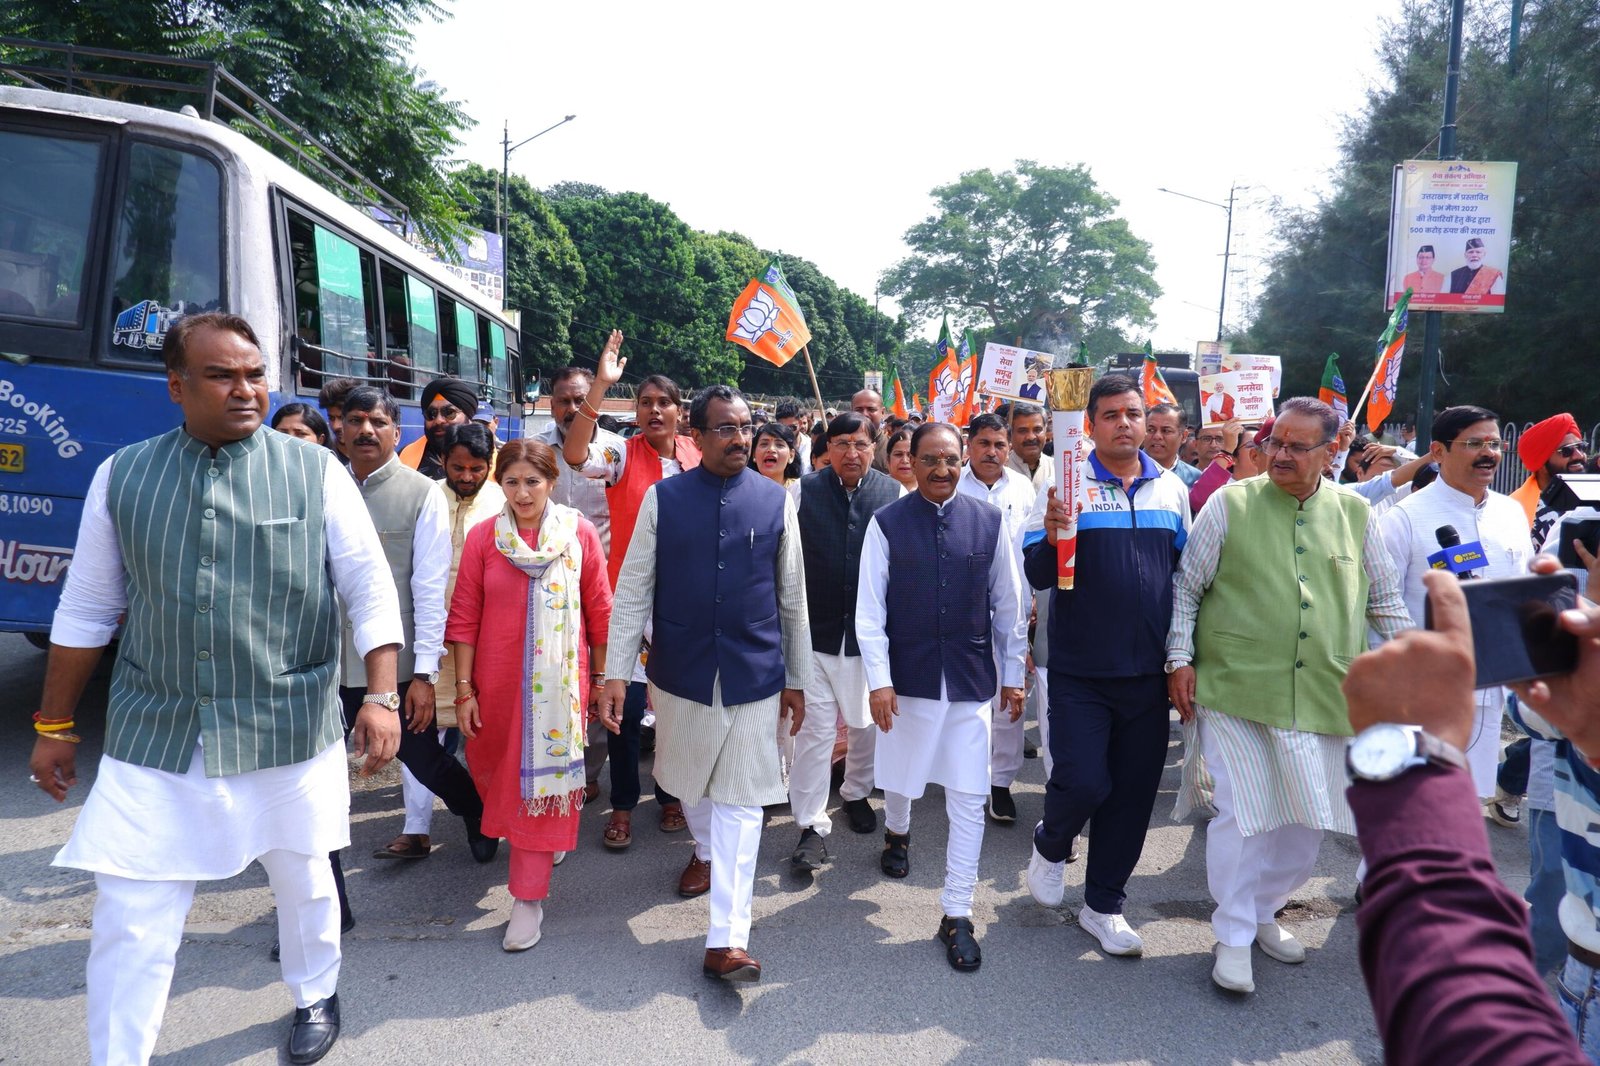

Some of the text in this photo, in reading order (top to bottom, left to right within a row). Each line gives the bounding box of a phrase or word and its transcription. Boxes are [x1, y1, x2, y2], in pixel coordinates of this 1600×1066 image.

[1460, 192, 1489, 201] प्रस्तावित
[1445, 204, 1460, 212] मेला
[1416, 214, 1425, 222] की
[1454, 215, 1464, 225] हेतु
[1477, 216, 1491, 224] द्वारा
[1460, 226, 1469, 234] की
[1000, 356, 1013, 366] सेवा
[994, 377, 1010, 386] भारत
[1237, 381, 1264, 392] जनसेवा
[1091, 502, 1123, 512] INDIA
